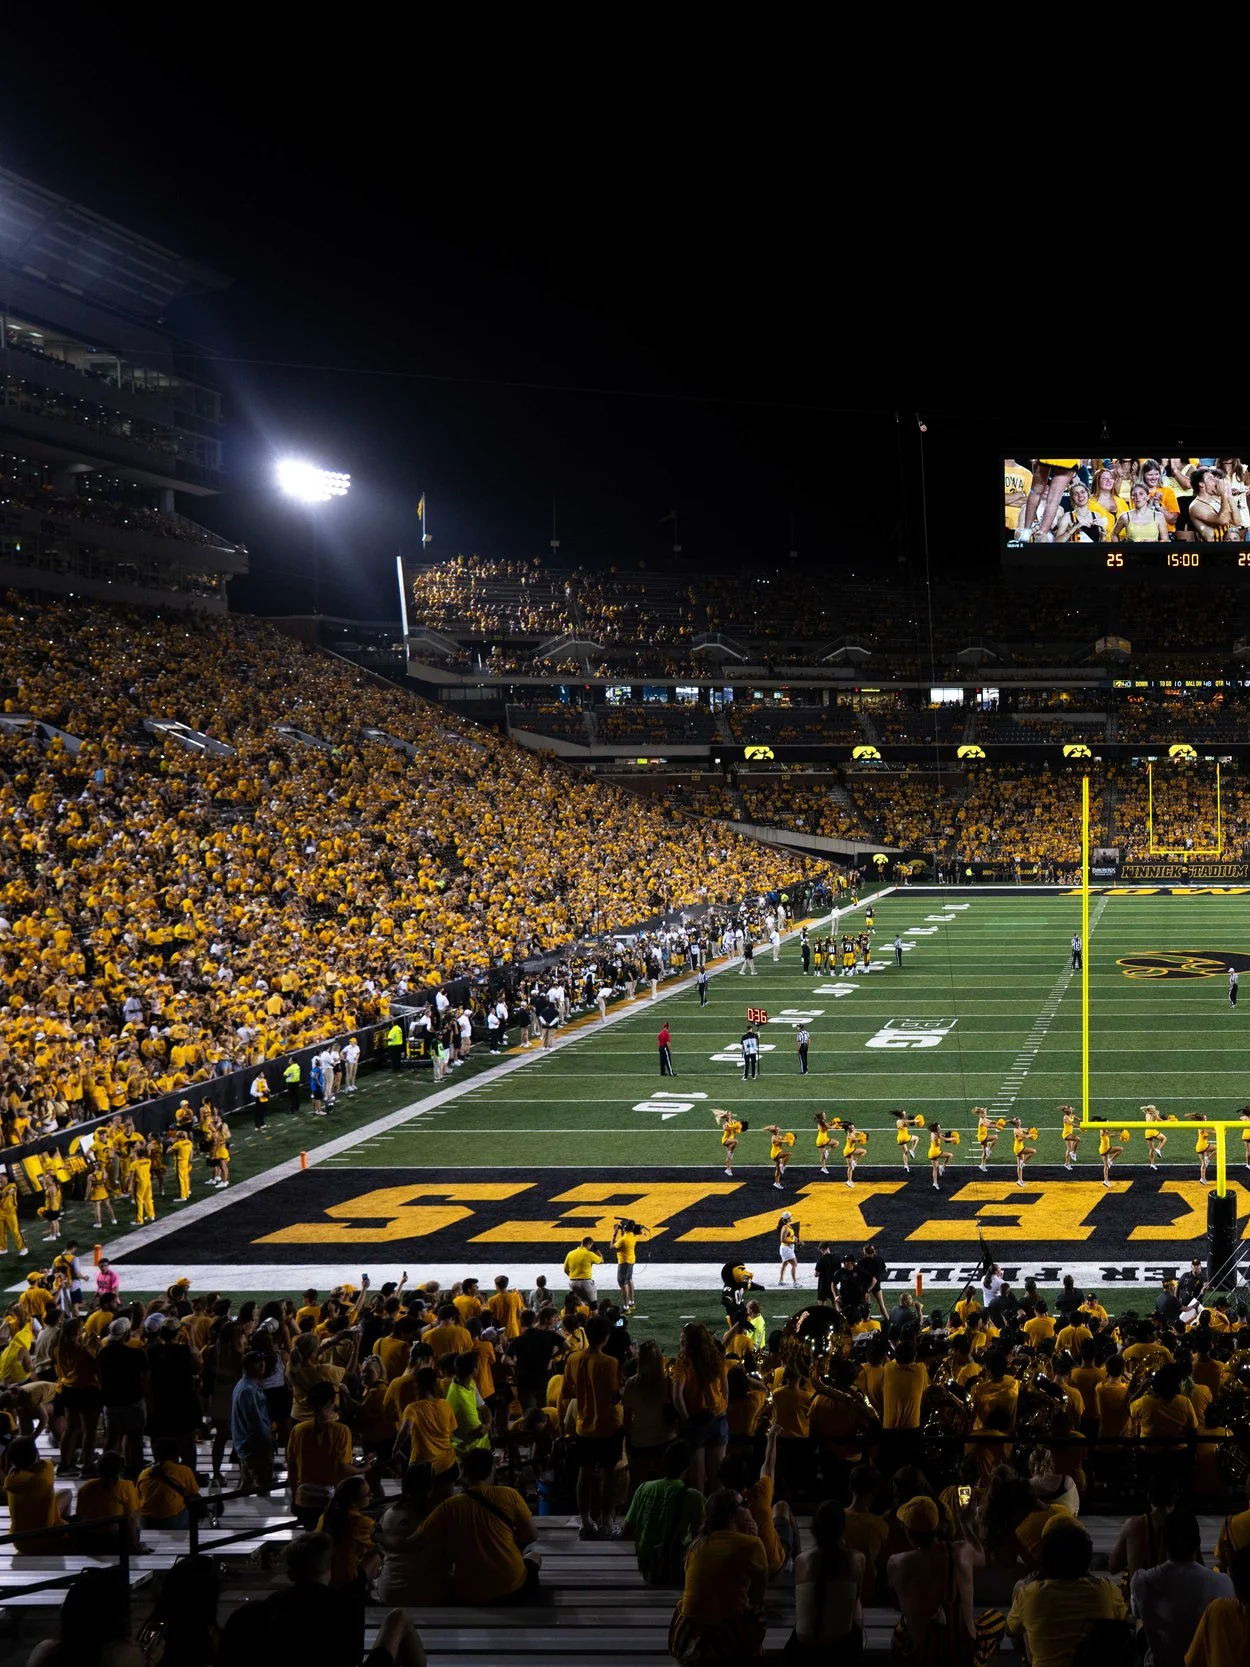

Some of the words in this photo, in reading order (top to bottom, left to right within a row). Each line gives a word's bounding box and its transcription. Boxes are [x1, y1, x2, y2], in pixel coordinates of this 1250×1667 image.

[1005, 476, 1024, 489] OWA
[1106, 554, 1123, 567] 25
[1166, 554, 1199, 567] 15:00
[1121, 865, 1183, 879] KINNICK
[1187, 864, 1249, 878] STADIUM
[631, 1091, 709, 1113] 10
